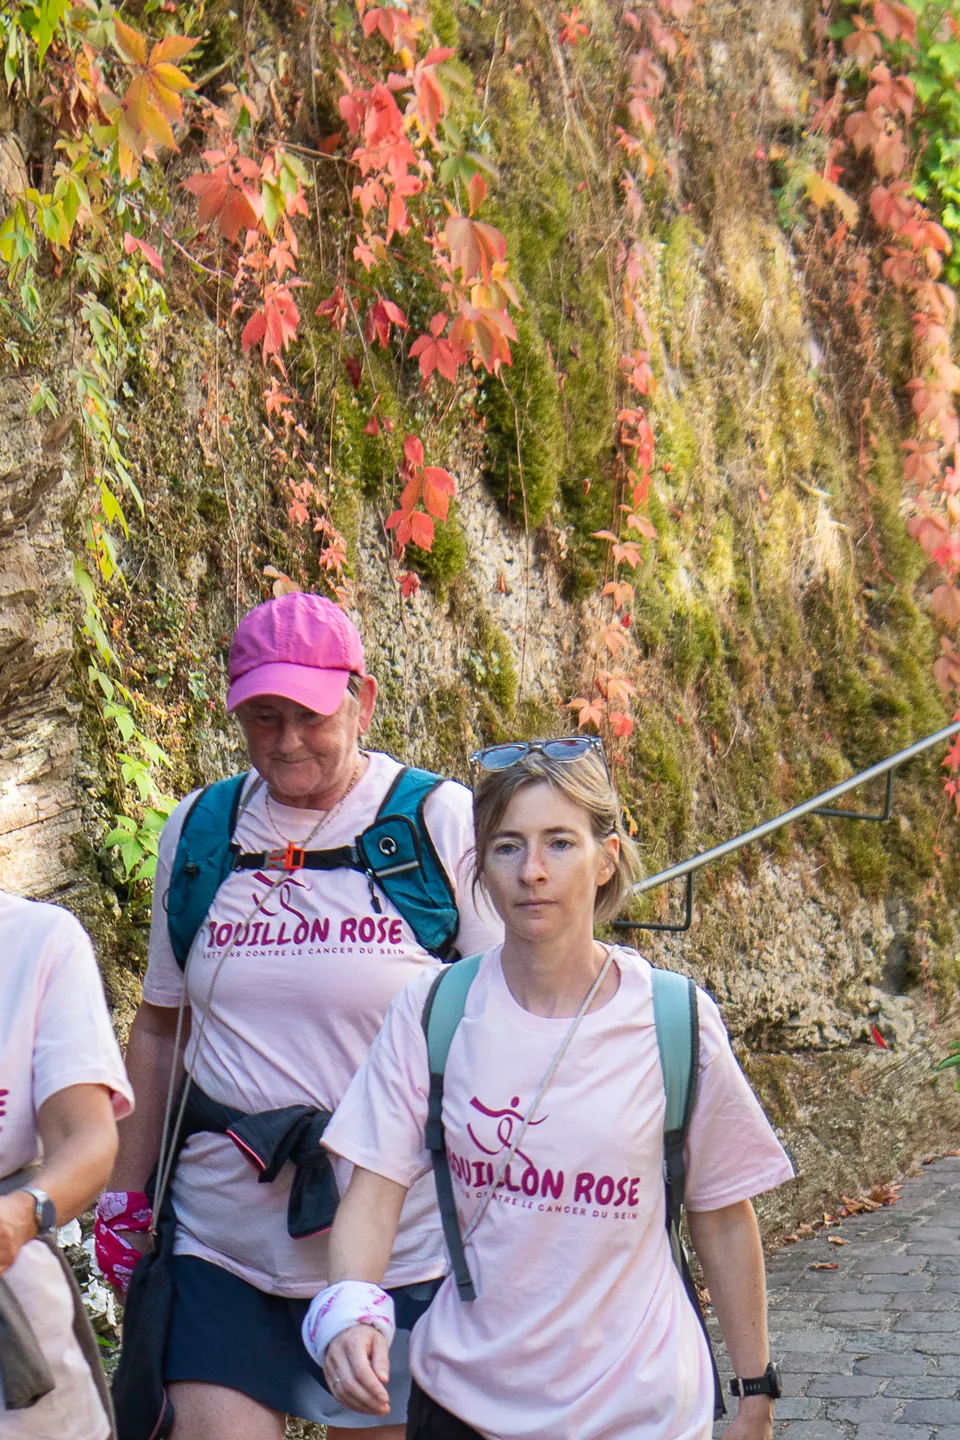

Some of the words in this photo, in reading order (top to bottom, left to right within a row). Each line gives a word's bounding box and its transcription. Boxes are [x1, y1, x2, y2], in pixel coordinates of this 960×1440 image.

[339, 917, 403, 945] ROSE
[245, 948, 287, 957] CONTRE
[291, 948, 303, 956] LE
[307, 946, 354, 955] CANCER
[359, 946, 374, 954] DU
[379, 947, 405, 955] SEIN
[446, 1146, 565, 1199] OUILLON
[574, 1171, 641, 1207] ROSE
[521, 1200, 534, 1210] LE
[538, 1203, 587, 1216] CANCER
[592, 1209, 609, 1218] DU
[613, 1211, 638, 1220] SEIN
